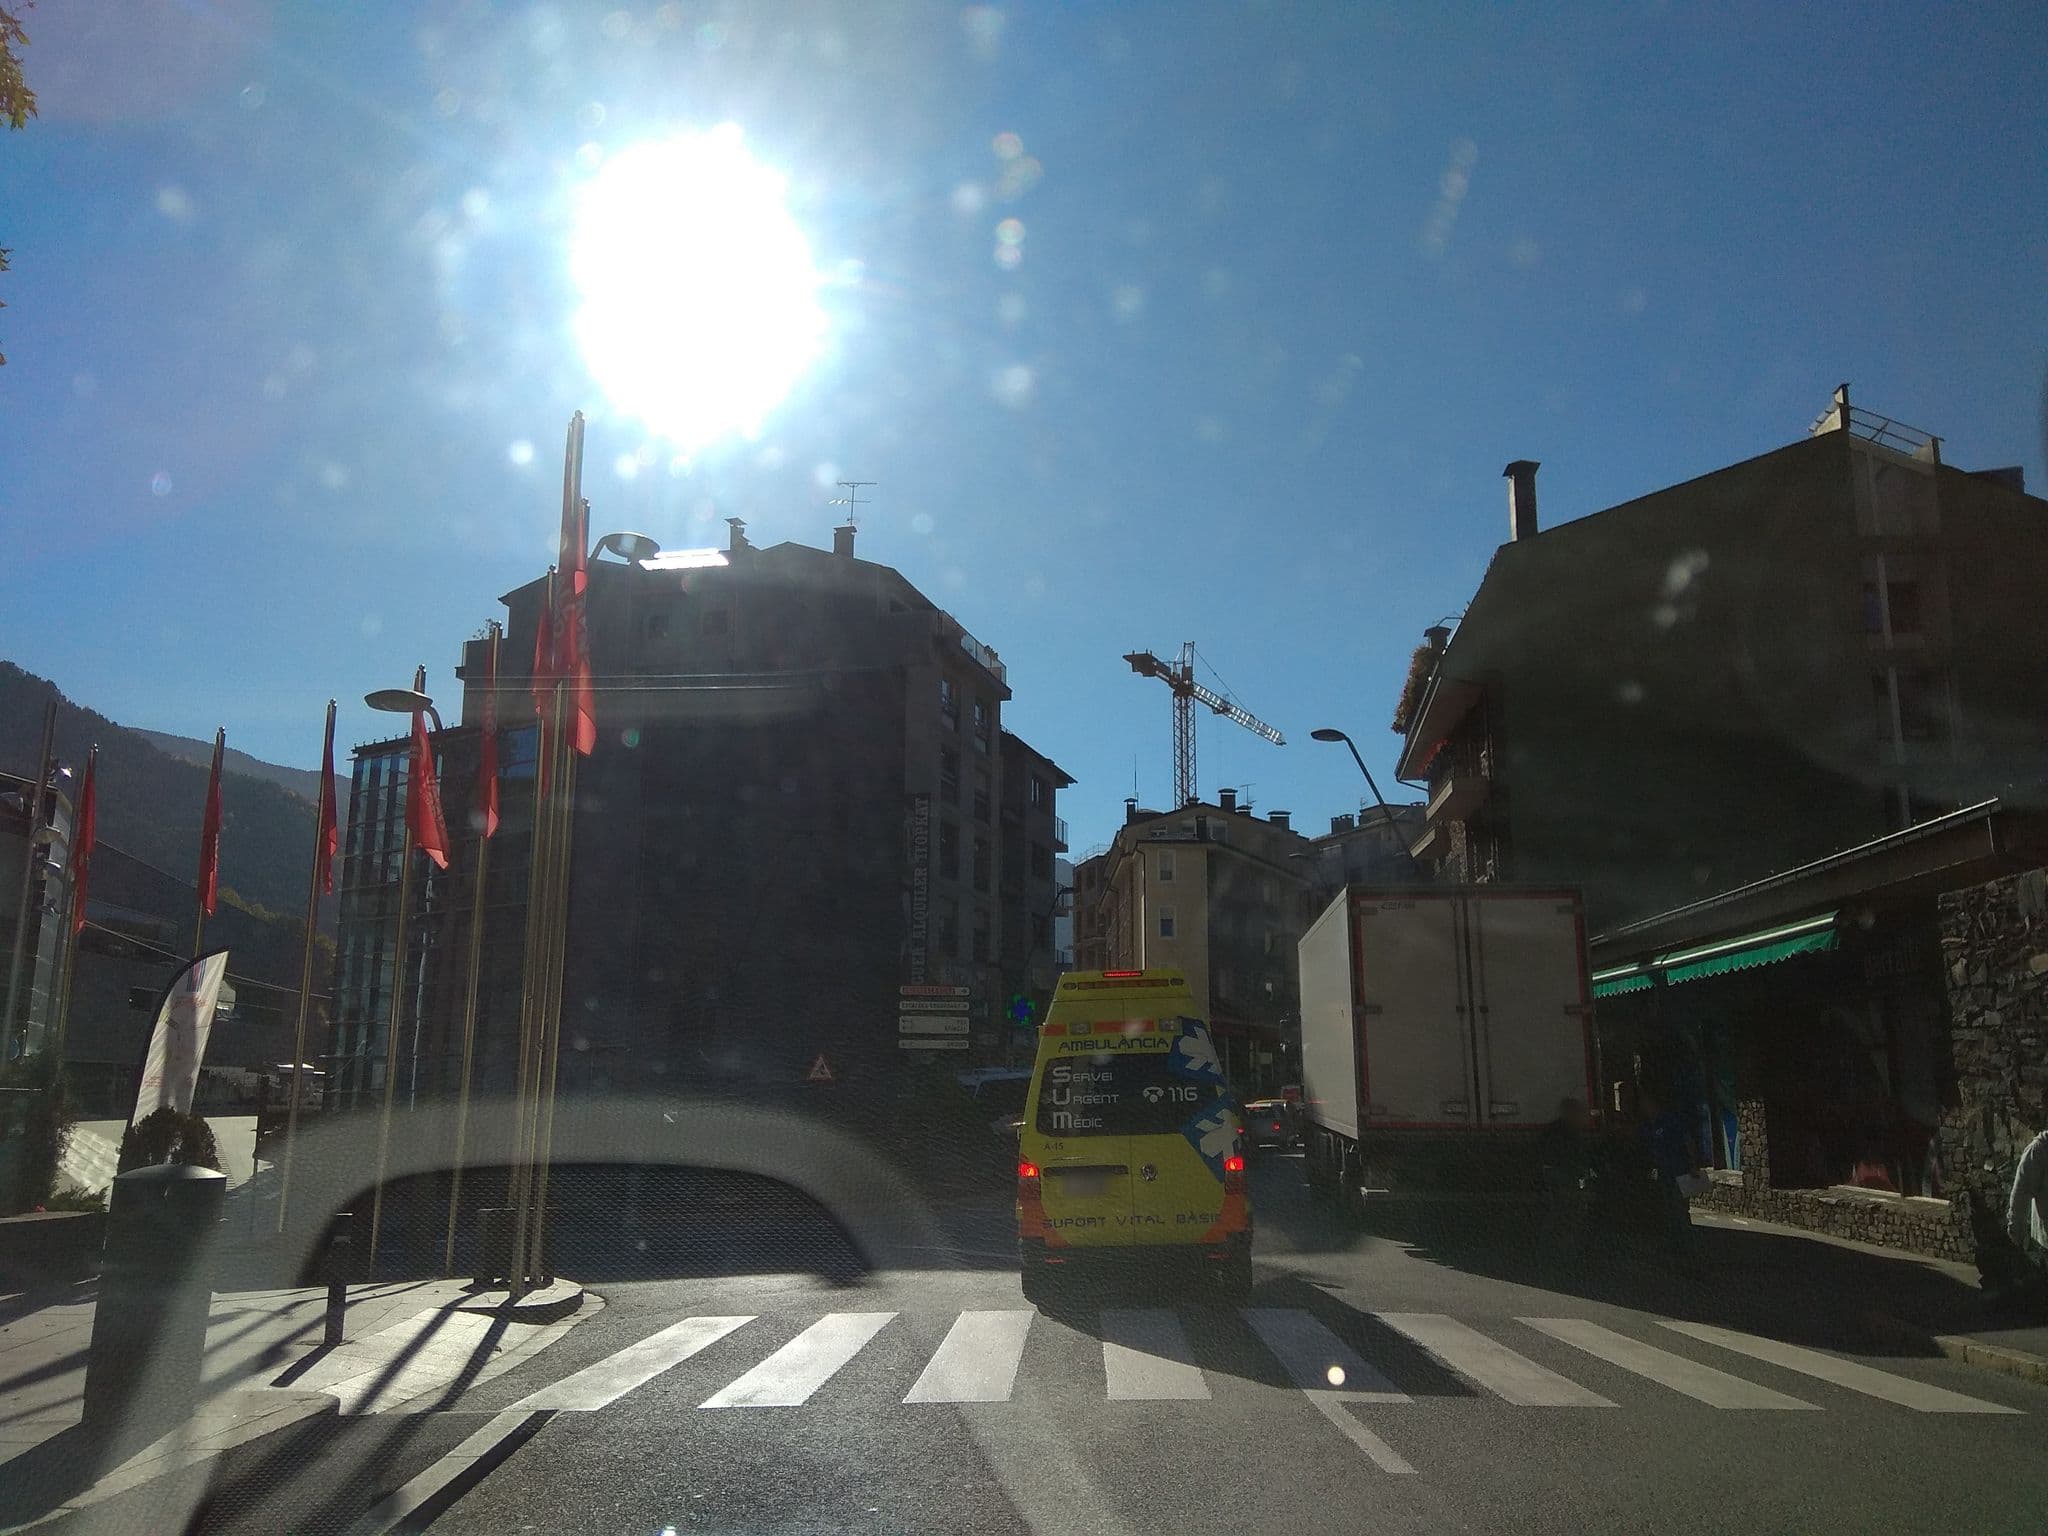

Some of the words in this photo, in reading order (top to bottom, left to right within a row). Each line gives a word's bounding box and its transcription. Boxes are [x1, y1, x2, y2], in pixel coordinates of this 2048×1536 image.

[1168, 1086, 1198, 1102] 116
[1042, 1216, 1106, 1230] SUPORT
[1116, 1214, 1166, 1226] VITAL
